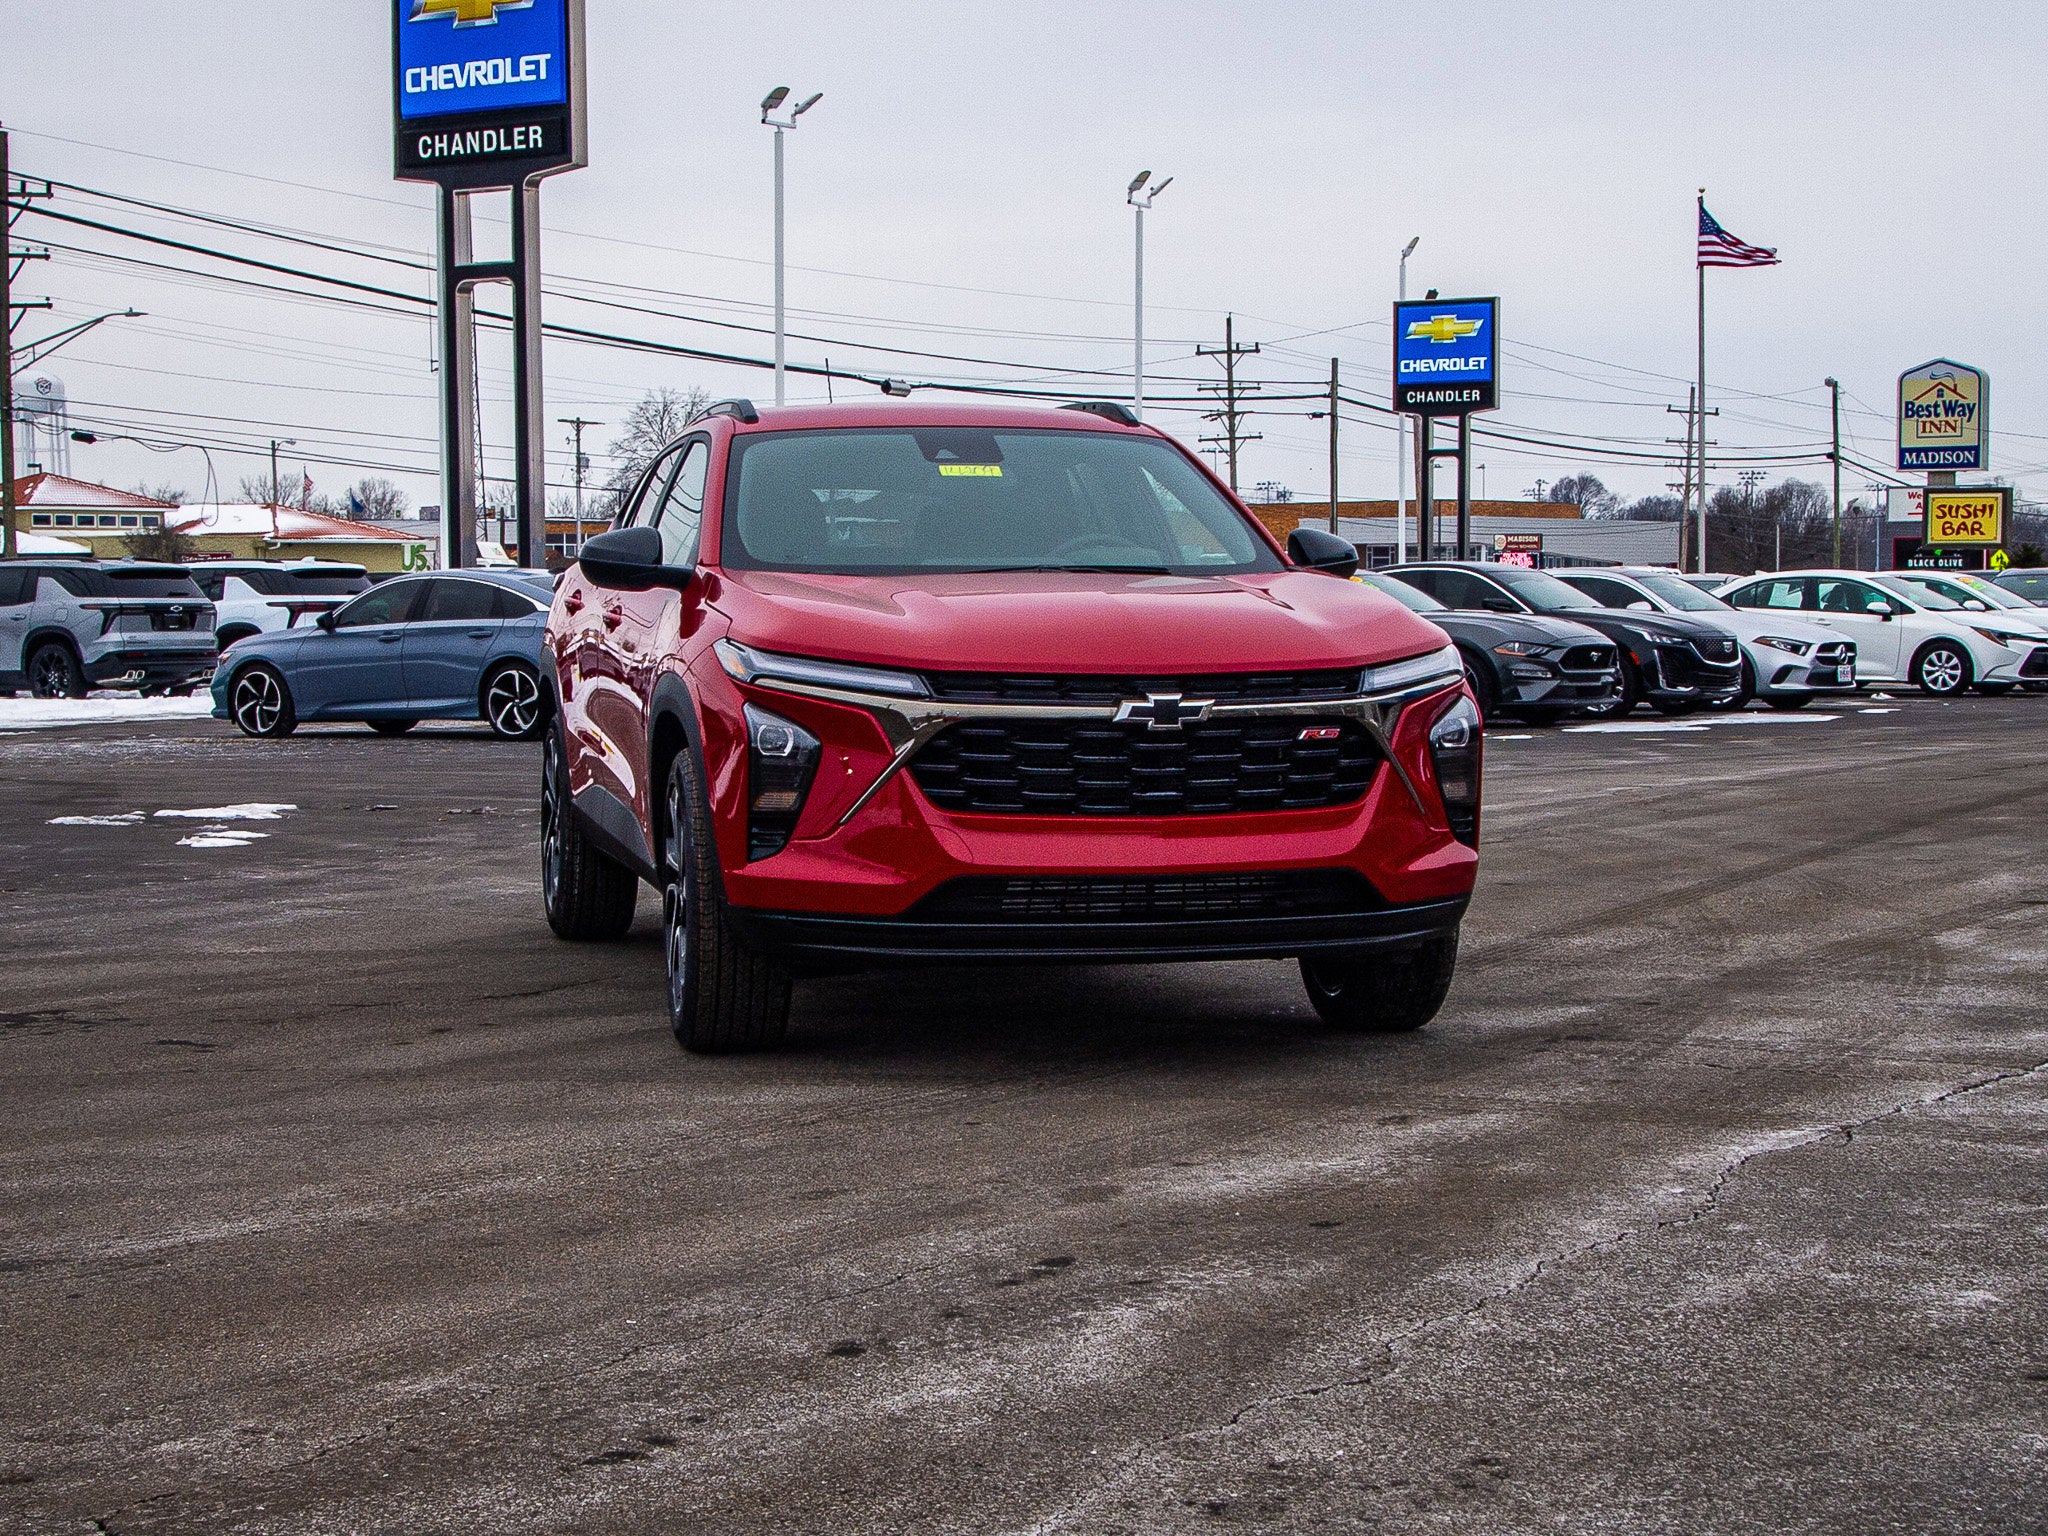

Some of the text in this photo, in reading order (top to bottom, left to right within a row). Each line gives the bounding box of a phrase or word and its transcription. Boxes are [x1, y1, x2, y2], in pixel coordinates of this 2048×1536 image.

[405, 53, 552, 93] CHEVROLET
[418, 125, 543, 158] CHANDLER
[1400, 356, 1487, 373] CHEVROLET
[1406, 389, 1481, 403] CHANDLER
[1904, 399, 1977, 423] Best Way
[1920, 419, 1959, 434] INN
[1903, 451, 1976, 465] MADISON
[1935, 503, 1995, 520] SUSHI
[1941, 520, 1986, 536] BAR
[1507, 535, 1539, 543] MADISON
[1907, 559, 1964, 568] BLACK OLIVE
[1298, 728, 1341, 740] RS
